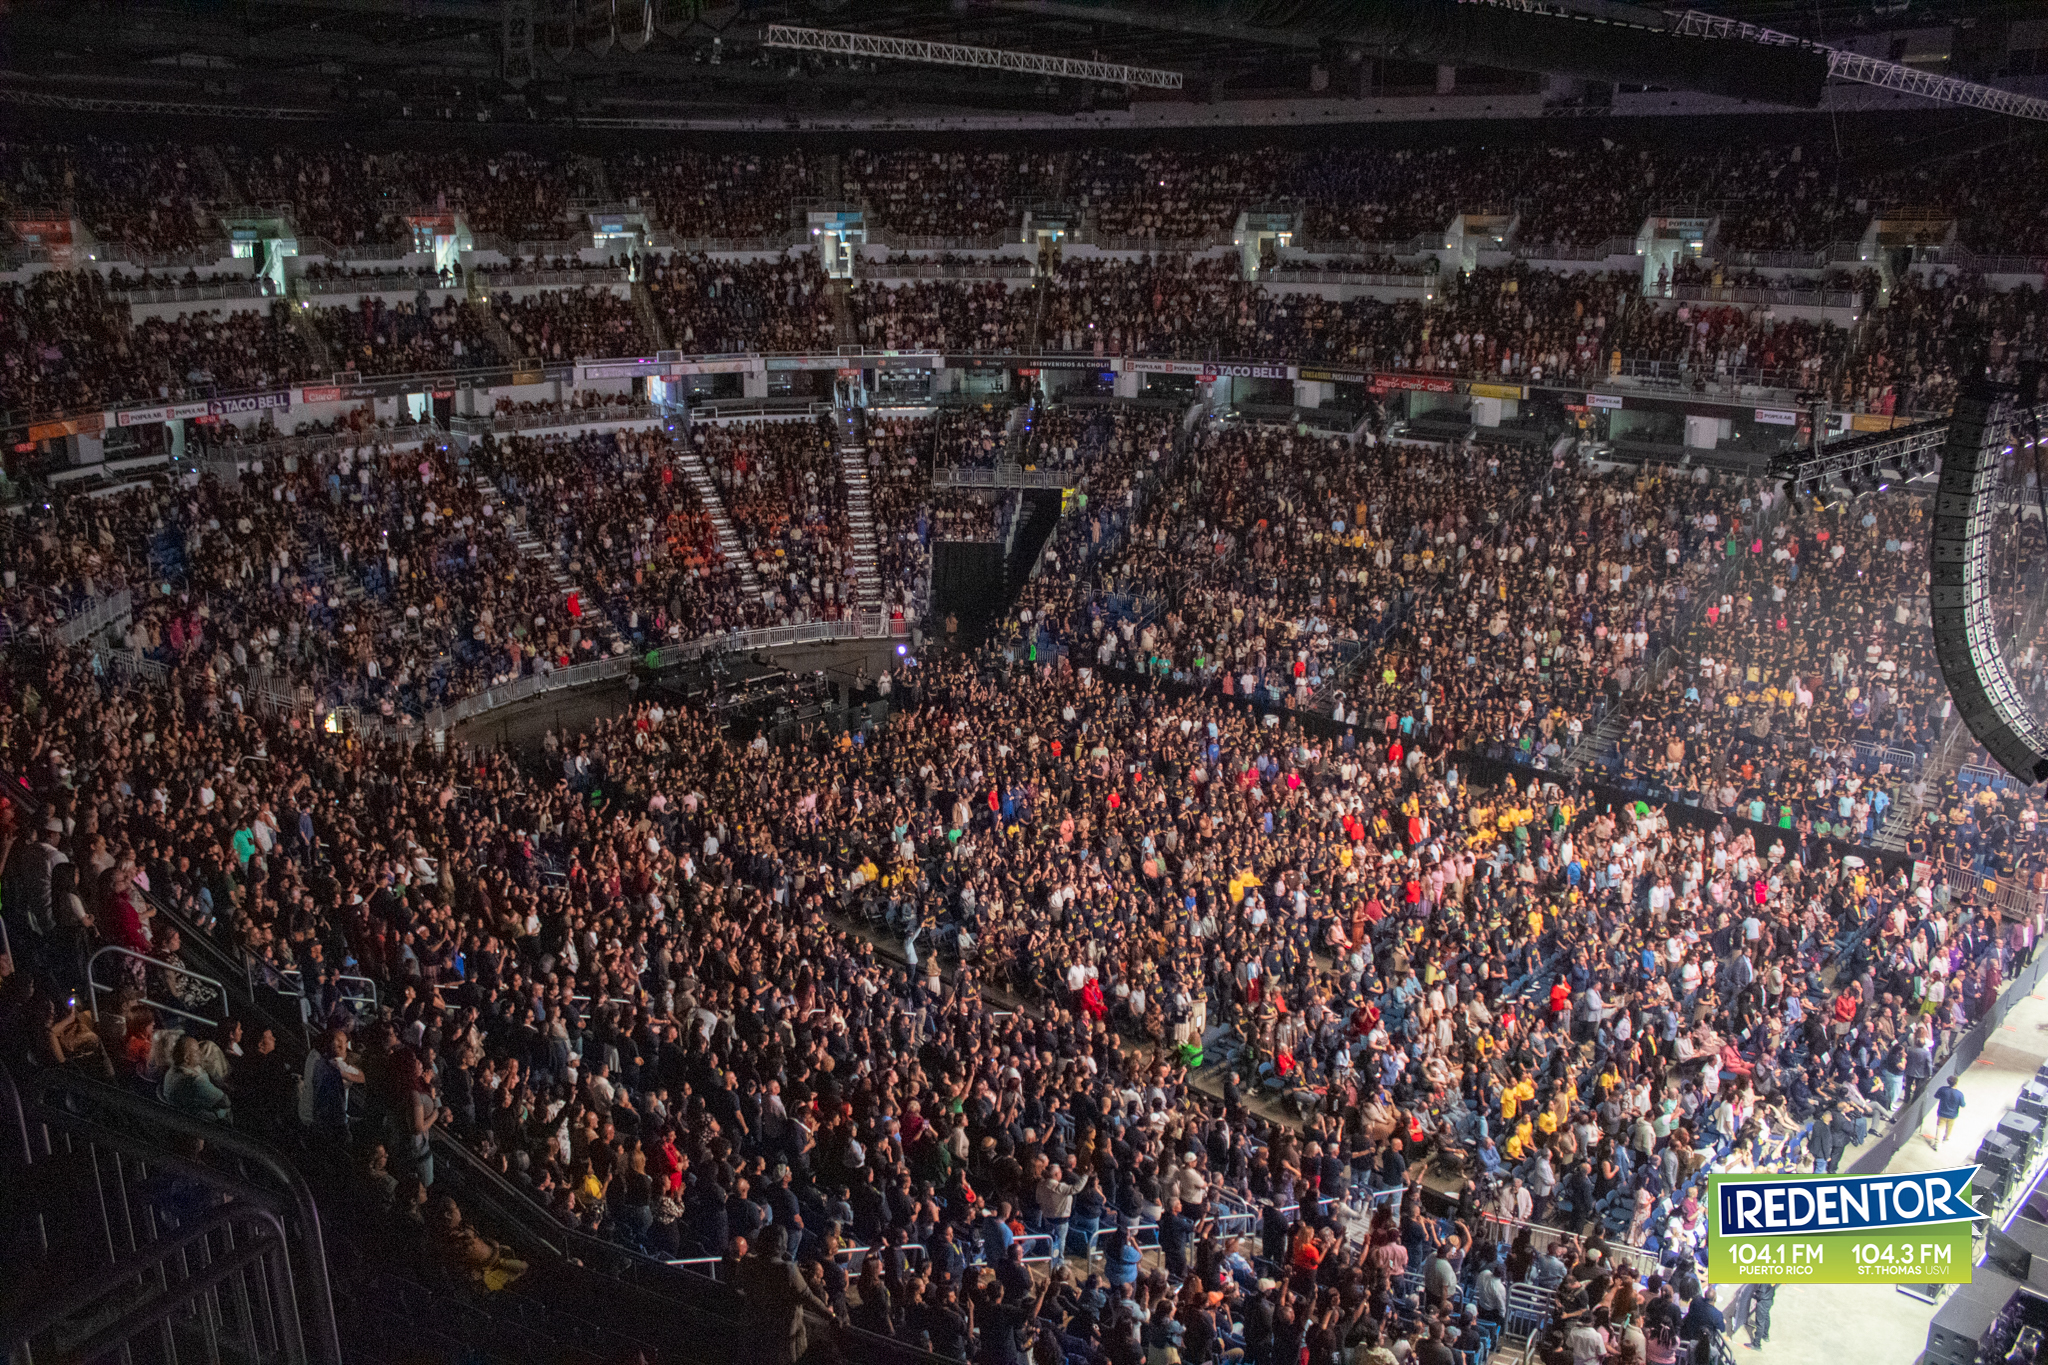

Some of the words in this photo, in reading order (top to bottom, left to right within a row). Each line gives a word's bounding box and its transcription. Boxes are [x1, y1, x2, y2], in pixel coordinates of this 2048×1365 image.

[1218, 365, 1250, 377] TACO
[1252, 367, 1283, 379] BELL
[1375, 379, 1398, 388] Claro
[1400, 380, 1424, 390] Claro
[1427, 382, 1450, 392] Claro
[308, 391, 334, 401] Claro
[223, 398, 256, 412] TACO
[258, 395, 288, 409] BELL
[1595, 397, 1621, 405] POPULAR
[176, 407, 206, 416] POPULAR
[130, 412, 163, 421] POPULAR
[1764, 413, 1793, 421] POPULAR
